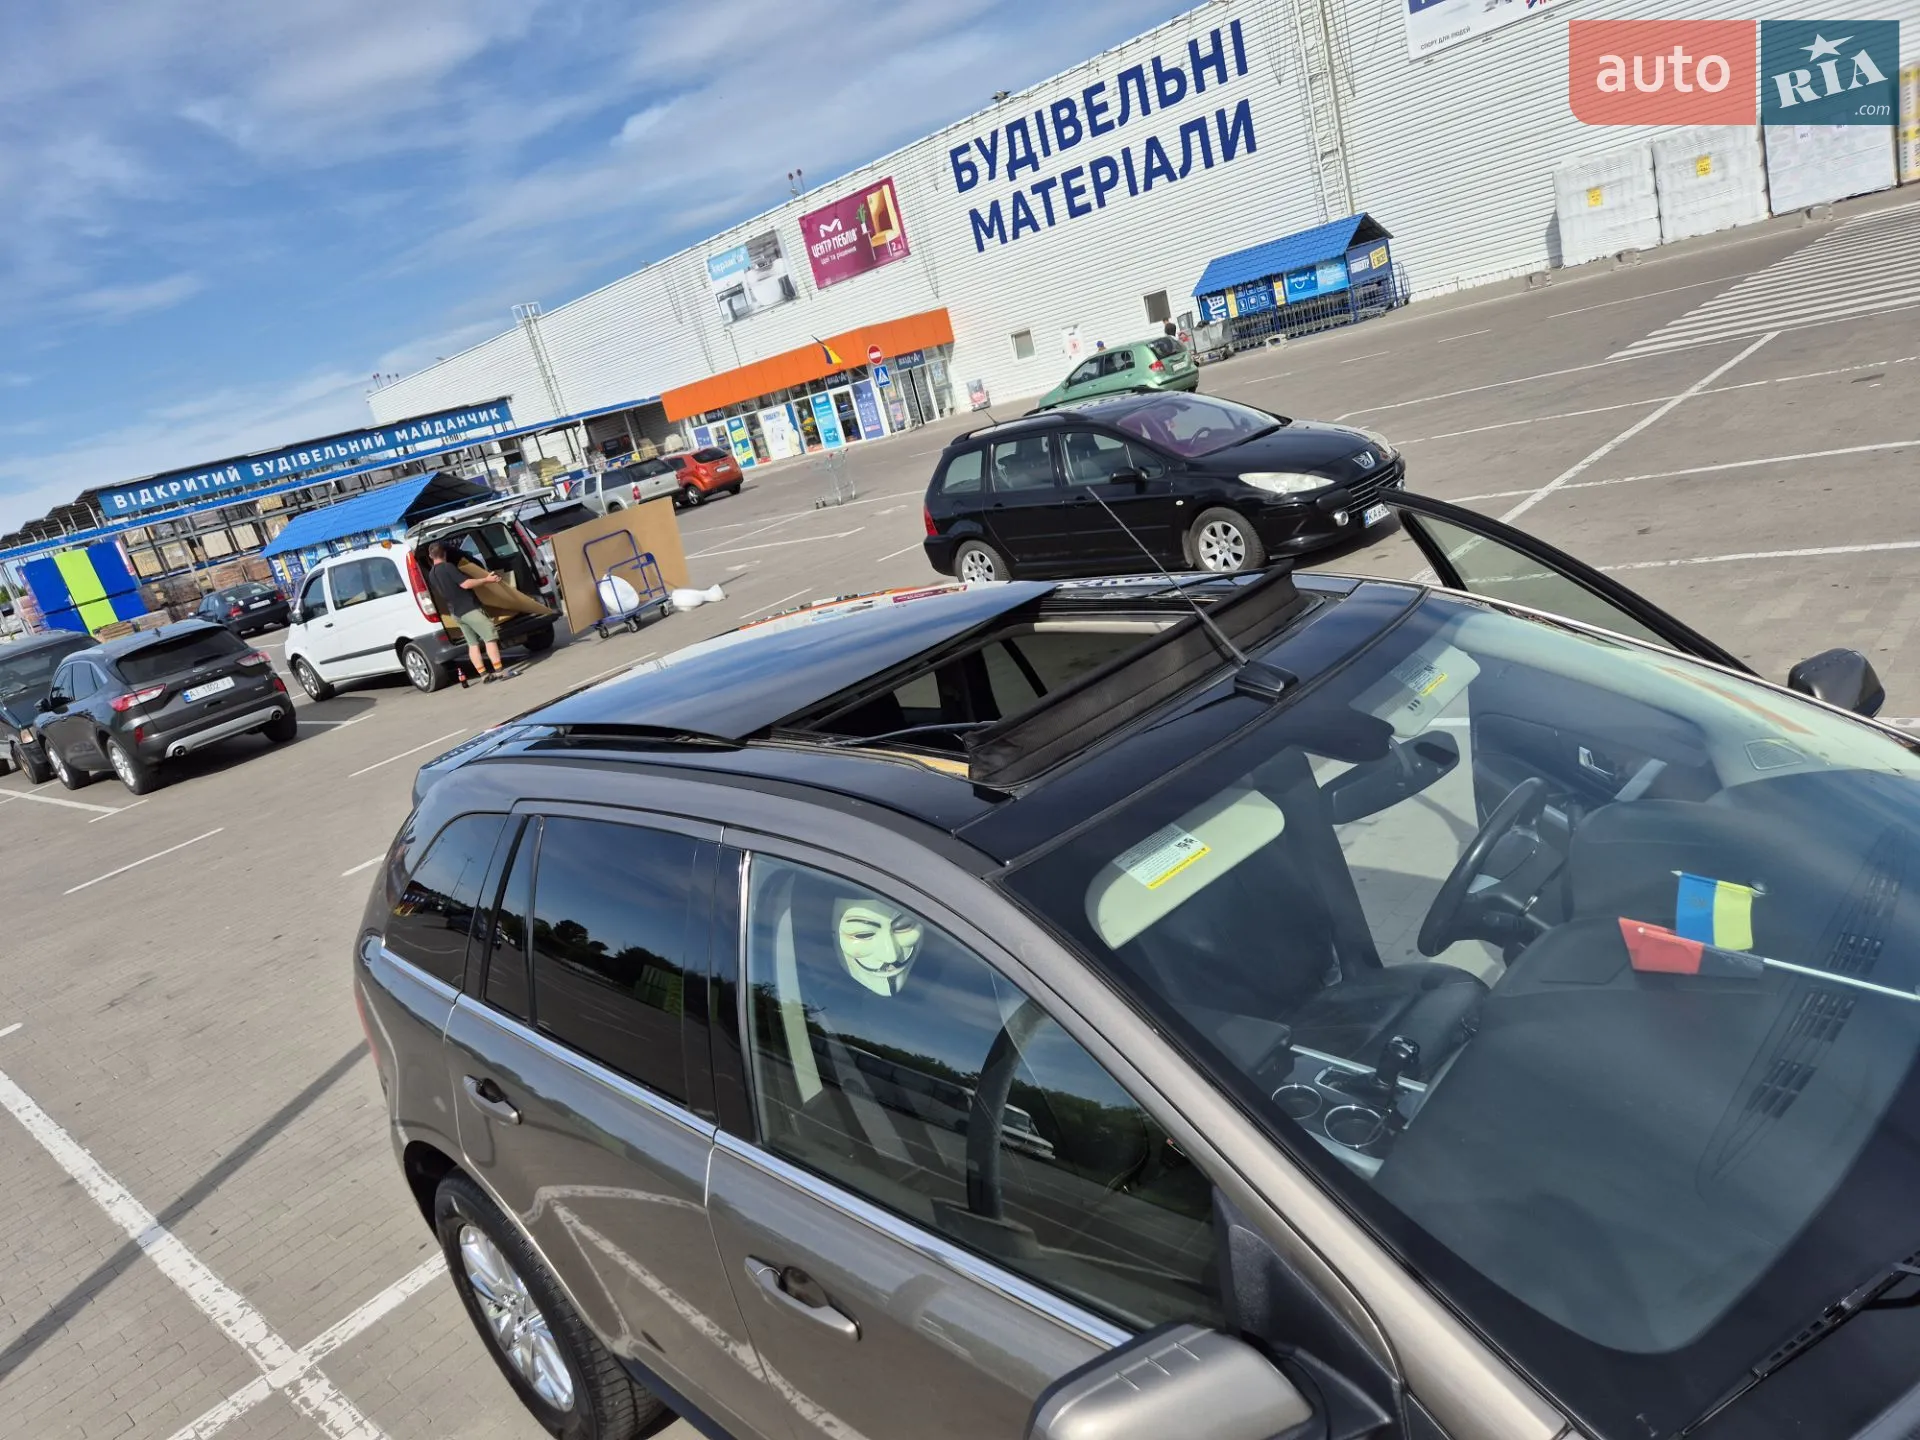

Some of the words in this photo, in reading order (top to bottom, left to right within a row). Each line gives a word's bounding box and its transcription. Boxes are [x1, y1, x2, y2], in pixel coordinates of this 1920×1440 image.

[949, 18, 1248, 193] БУДІВЕЛЬНІ
[968, 98, 1257, 253] МАТЕРІАЛИ
[811, 239, 832, 258] ЦЕНТР
[113, 465, 241, 509] ВІДКРИТИЙ
[251, 432, 386, 477] БУДІВЕЛЬНИЙ
[394, 408, 501, 442] МАЙДАНЧИК
